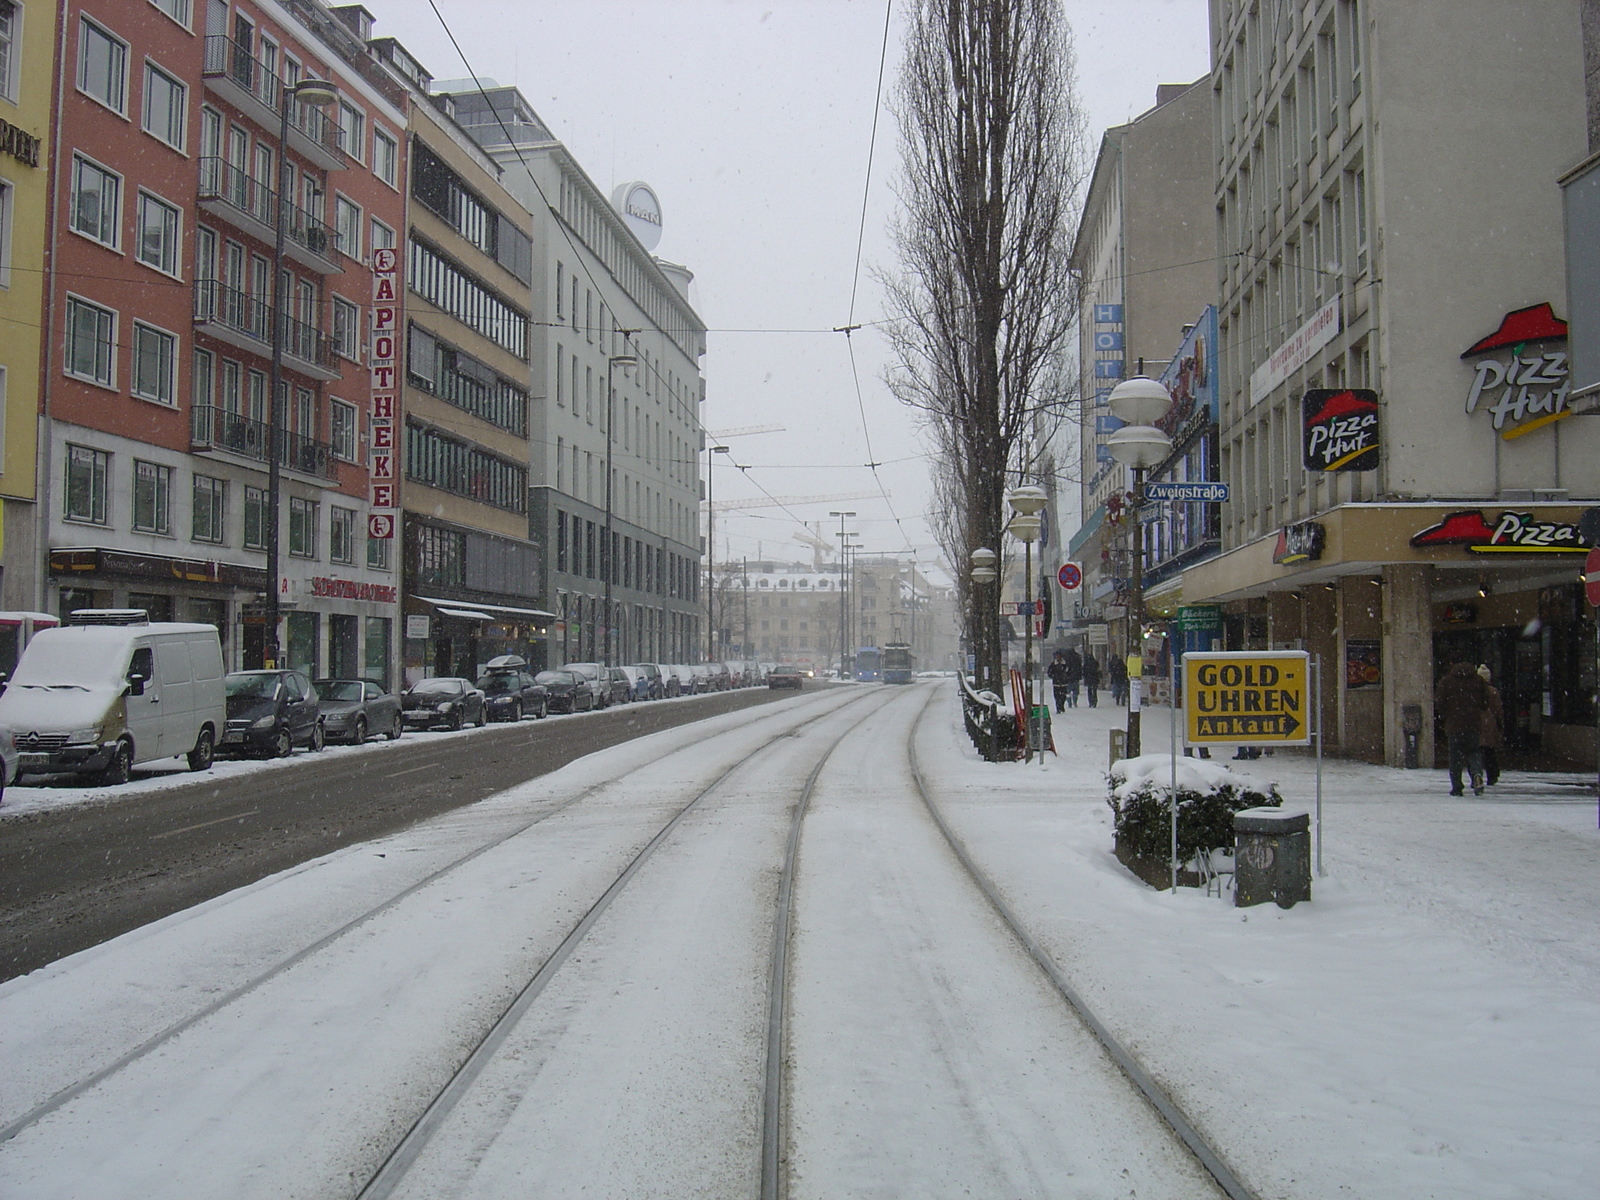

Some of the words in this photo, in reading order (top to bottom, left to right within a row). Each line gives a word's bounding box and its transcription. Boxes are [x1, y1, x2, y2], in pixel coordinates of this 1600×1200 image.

[630, 205, 660, 225] MAN
[1097, 307, 1114, 432] HOTEL
[1465, 343, 1570, 413] Pizz
[374, 279, 393, 506] APOTHEKE
[1488, 380, 1571, 429] Hut
[1309, 415, 1378, 457] Pizza
[1321, 431, 1372, 464] Hut
[1148, 485, 1225, 500] Zweigstraße
[1490, 515, 1574, 545] Pizza
[1181, 609, 1219, 618] Bäckerei
[1197, 689, 1299, 712] UHREN
[1200, 717, 1287, 734] Ankauf
